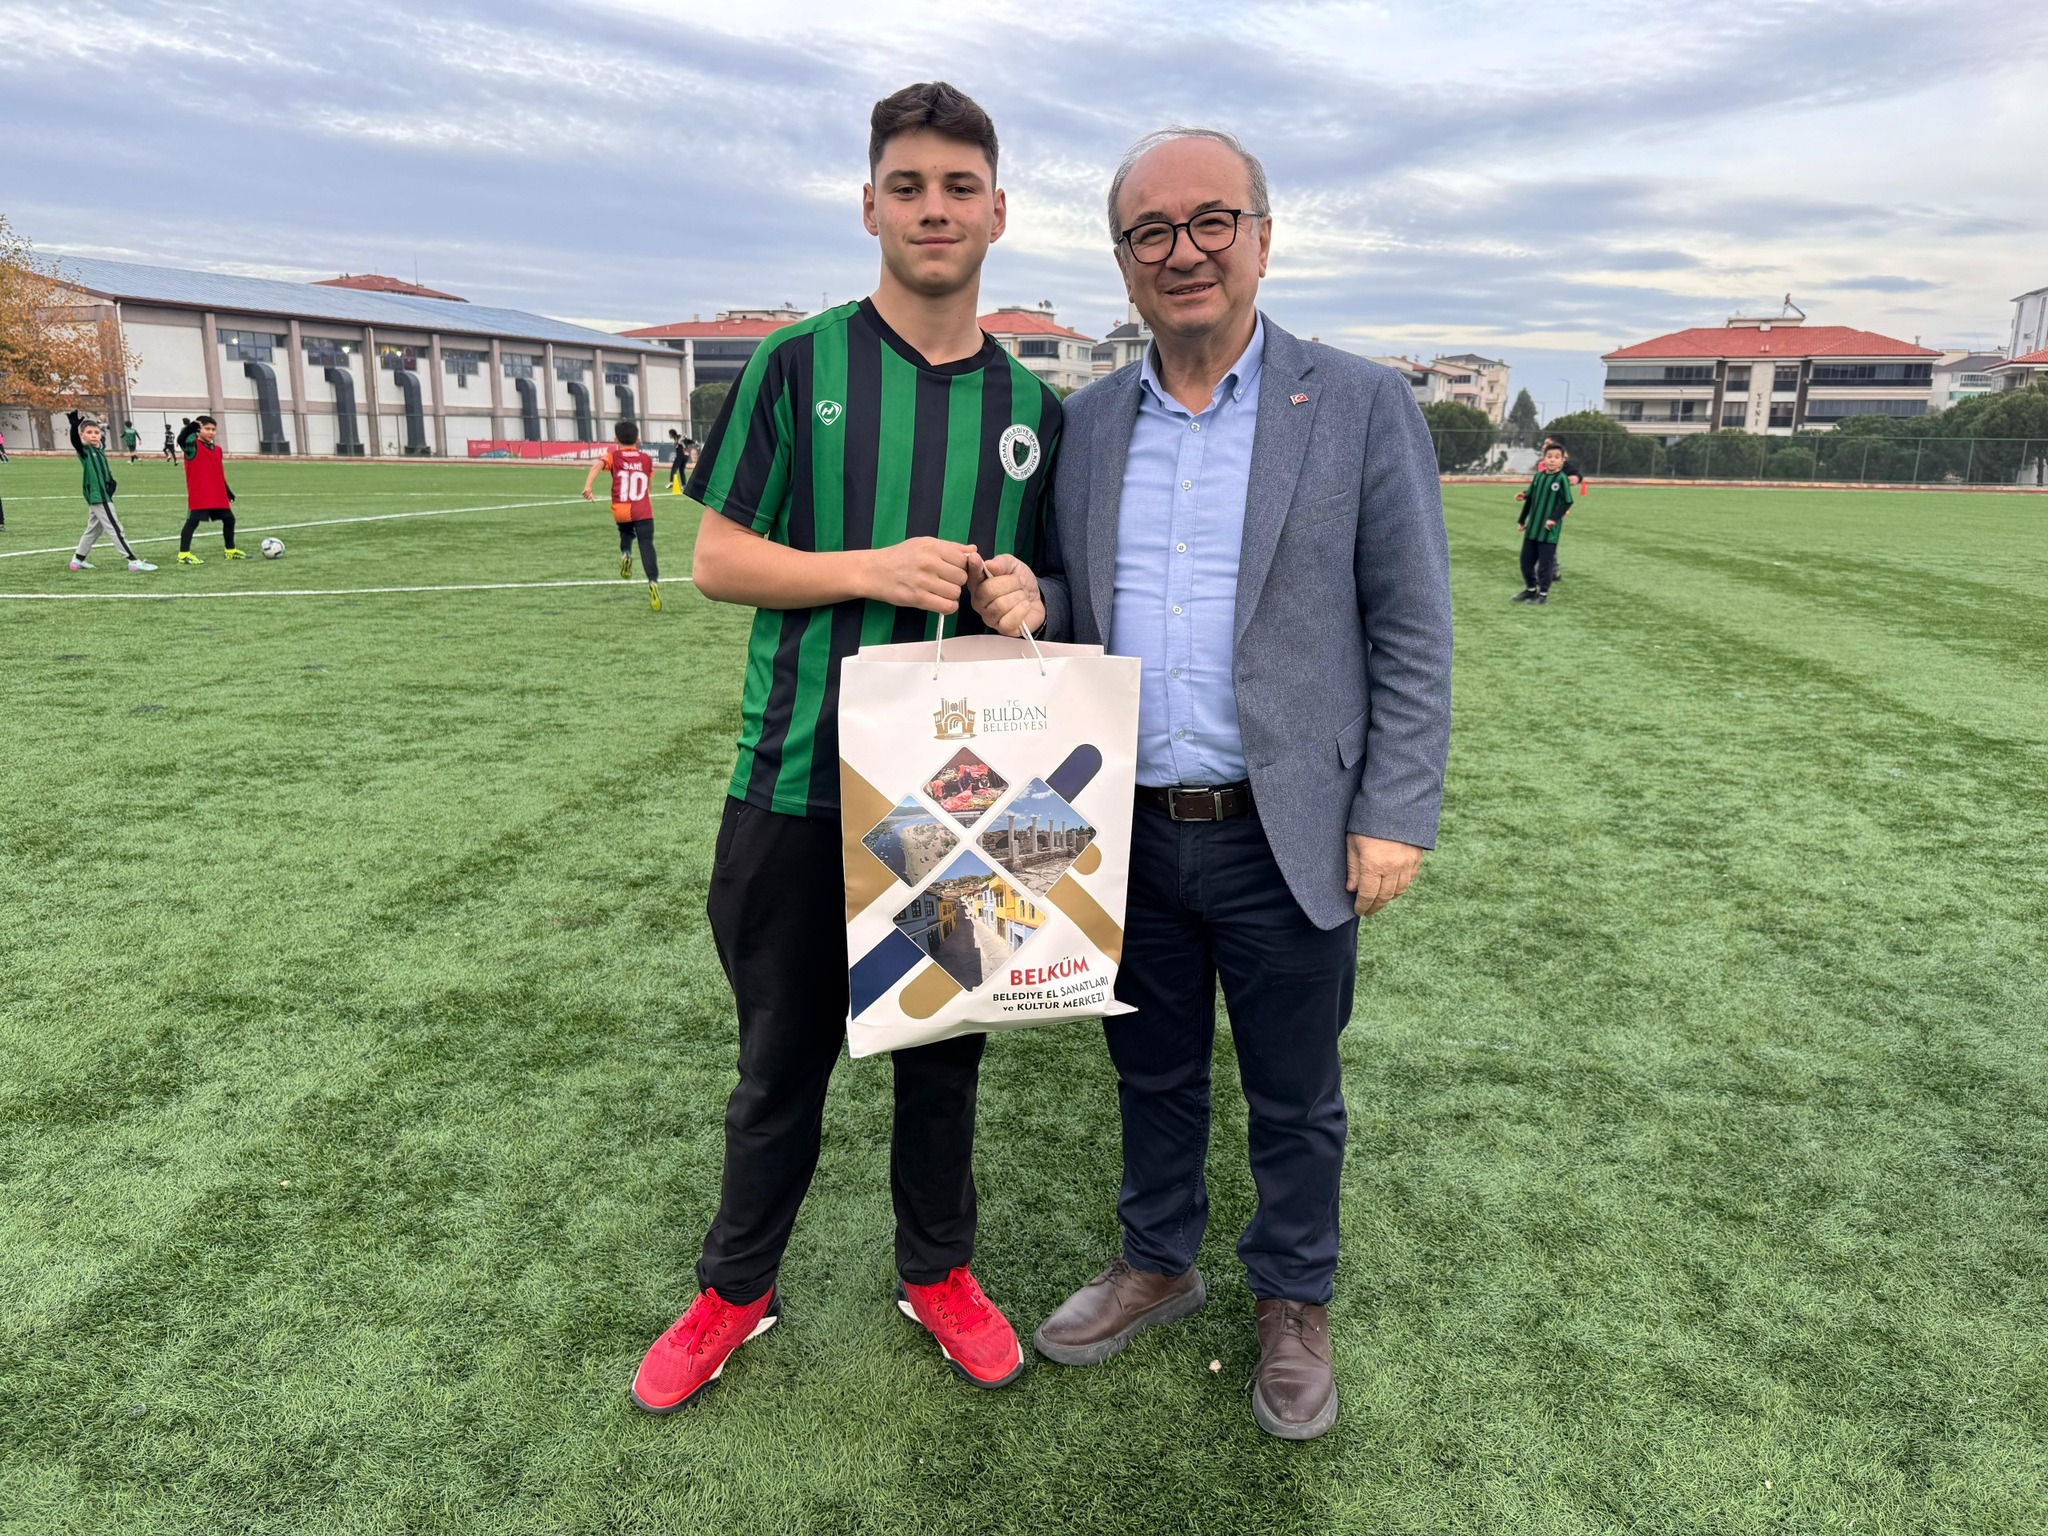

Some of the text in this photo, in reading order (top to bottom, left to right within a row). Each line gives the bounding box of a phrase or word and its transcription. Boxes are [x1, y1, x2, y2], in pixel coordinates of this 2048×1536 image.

[1002, 442, 1013, 472] BULDAN
[1028, 434, 1039, 454] SPOR
[617, 469, 648, 502] 10
[984, 706, 1047, 722] BULDAN
[1010, 955, 1090, 986] BELKÜM
[992, 975, 1109, 1002] BELEDİYE EL SANATLARI
[1017, 999, 1060, 1011] KÜLTÜR
[1062, 989, 1105, 1009] MERKEZİ
